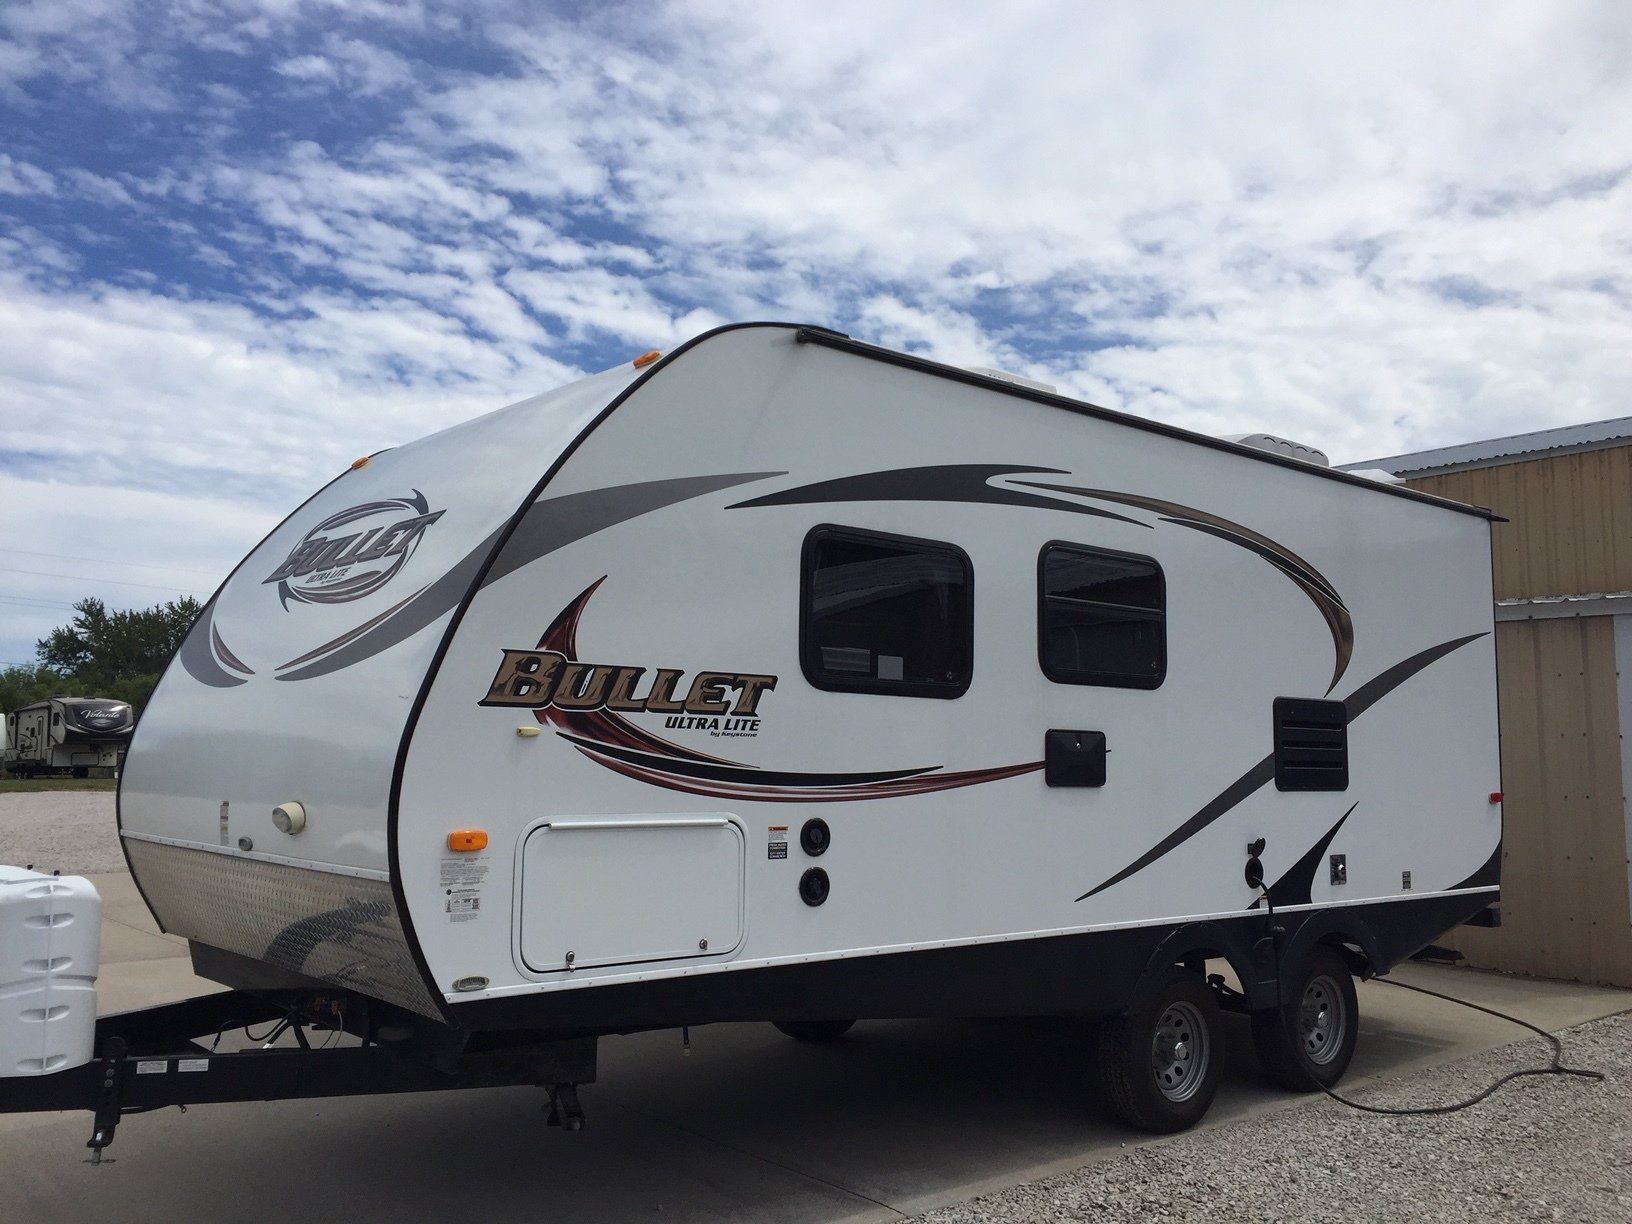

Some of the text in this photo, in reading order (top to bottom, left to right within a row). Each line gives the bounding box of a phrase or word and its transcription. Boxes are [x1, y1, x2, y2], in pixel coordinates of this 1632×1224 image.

[261, 509, 447, 584] BULLET
[329, 567, 351, 579] LITE
[477, 649, 778, 717] BULLET
[80, 709, 121, 719] Volante
[665, 716, 761, 732] ULTRA LITE
